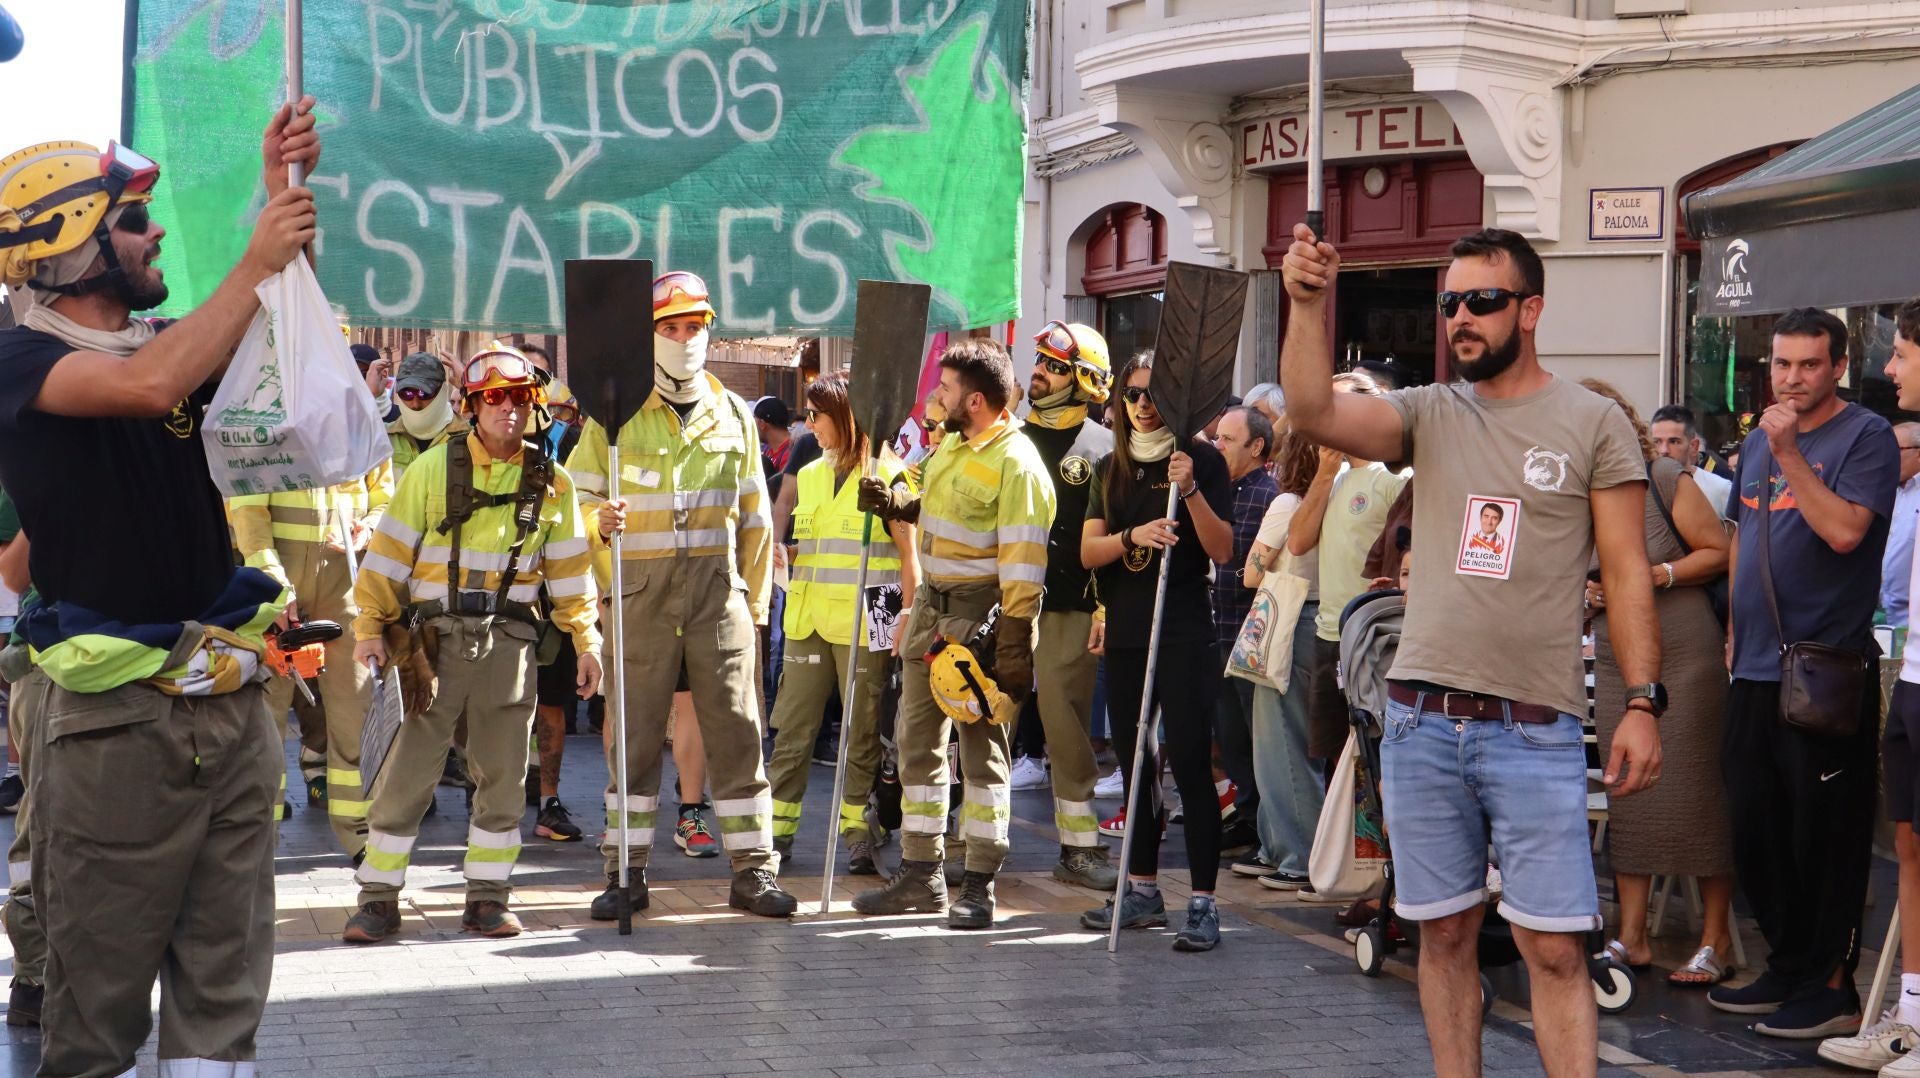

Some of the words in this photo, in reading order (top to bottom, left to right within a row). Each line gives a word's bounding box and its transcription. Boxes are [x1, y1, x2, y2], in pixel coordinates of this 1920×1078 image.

[367, 4, 782, 141] PÚBLICOS
[1243, 117, 1309, 165] CAS
[544, 131, 602, 200] Y
[1613, 198, 1641, 208] CALLE
[1604, 215, 1649, 228] PALOMA
[305, 173, 862, 334] STAES
[1715, 281, 1753, 298] ÁGUILA
[1465, 551, 1500, 561] PELIGRO
[1471, 560, 1503, 569] INCENDIO
